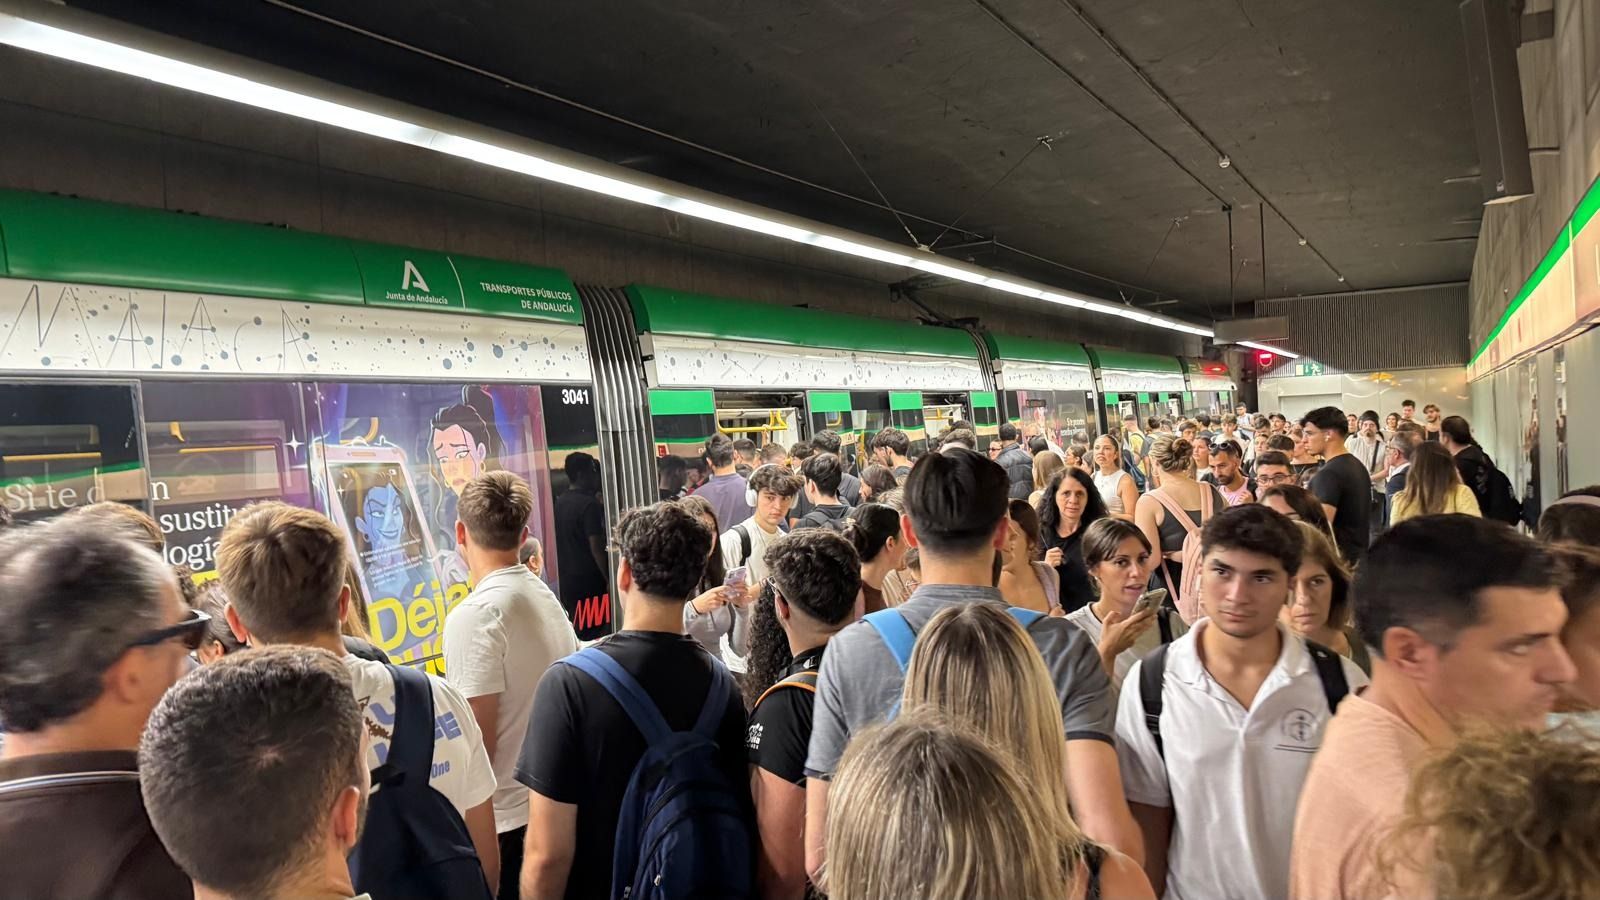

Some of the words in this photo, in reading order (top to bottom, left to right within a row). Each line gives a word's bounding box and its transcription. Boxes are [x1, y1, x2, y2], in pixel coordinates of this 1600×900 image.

[385, 291, 406, 301] Junta
[406, 292, 417, 302] de
[480, 282, 536, 297] TRANSPORTES
[536, 288, 572, 300] PÚBLICOS
[521, 300, 533, 309] DE
[533, 302, 575, 313] ANDALUCÍA
[561, 388, 589, 405] 3041
[5, 483, 36, 513] Si
[45, 484, 78, 510] te
